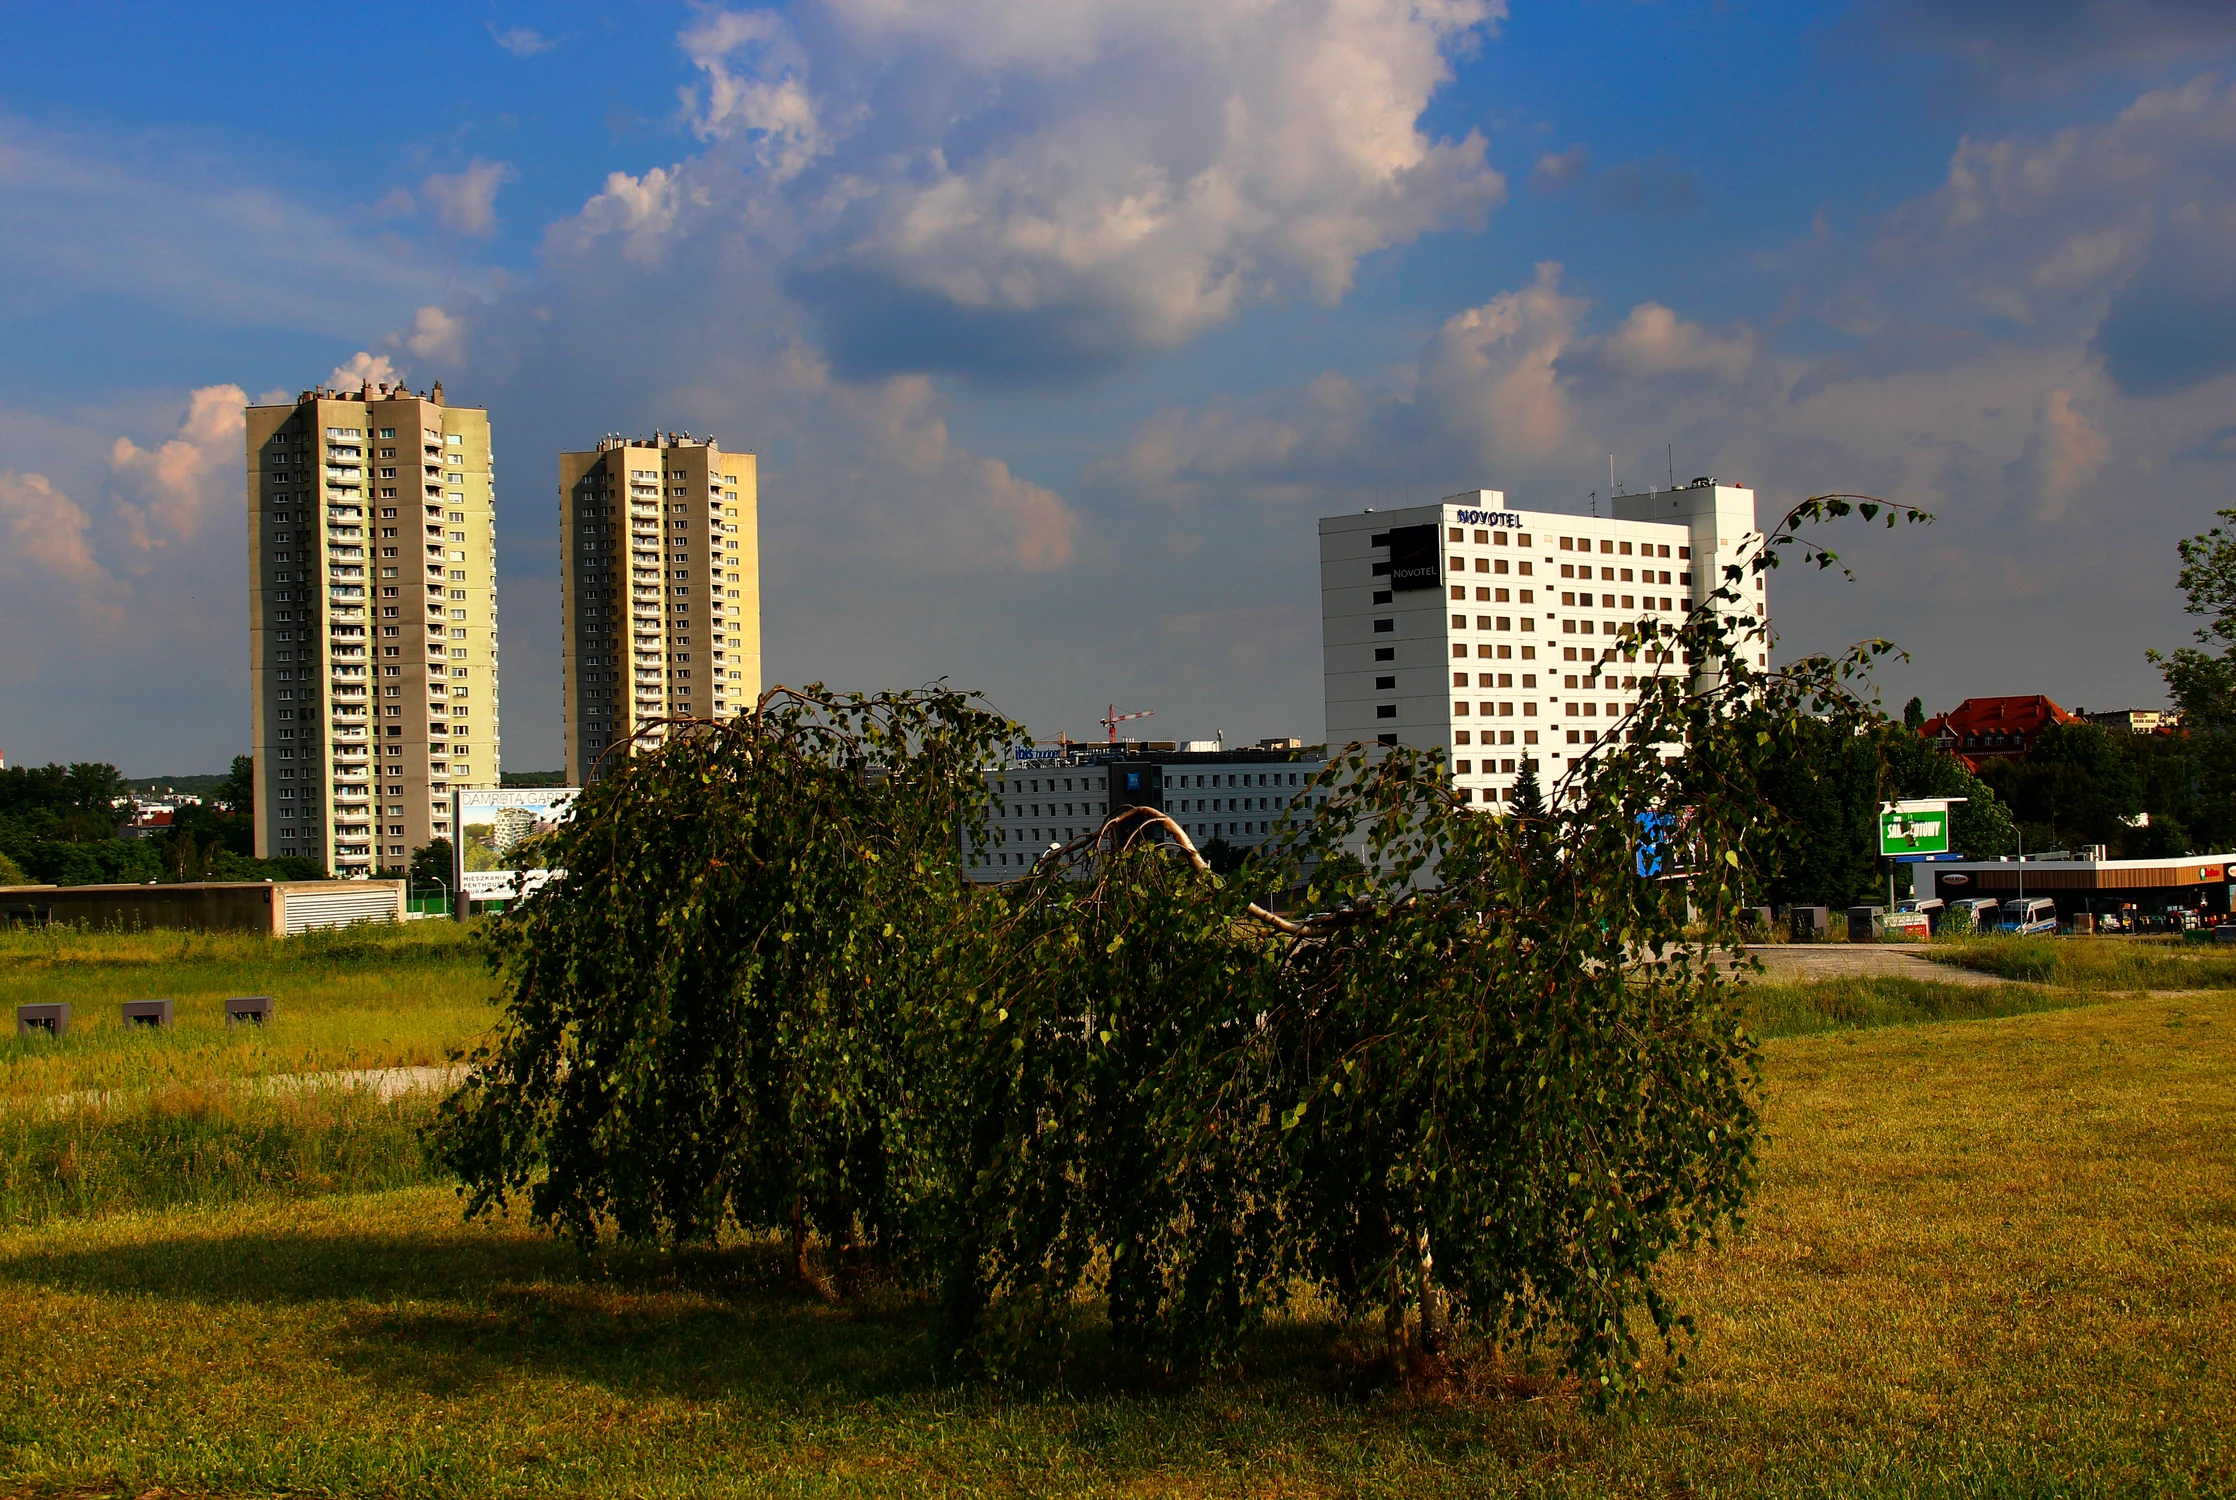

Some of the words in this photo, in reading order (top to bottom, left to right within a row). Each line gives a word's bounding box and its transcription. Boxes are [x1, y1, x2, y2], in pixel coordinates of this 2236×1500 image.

[1457, 509, 1523, 528] NOVOTEL
[1393, 566, 1437, 578] NOVOTEL
[1015, 745, 1034, 760] ibis
